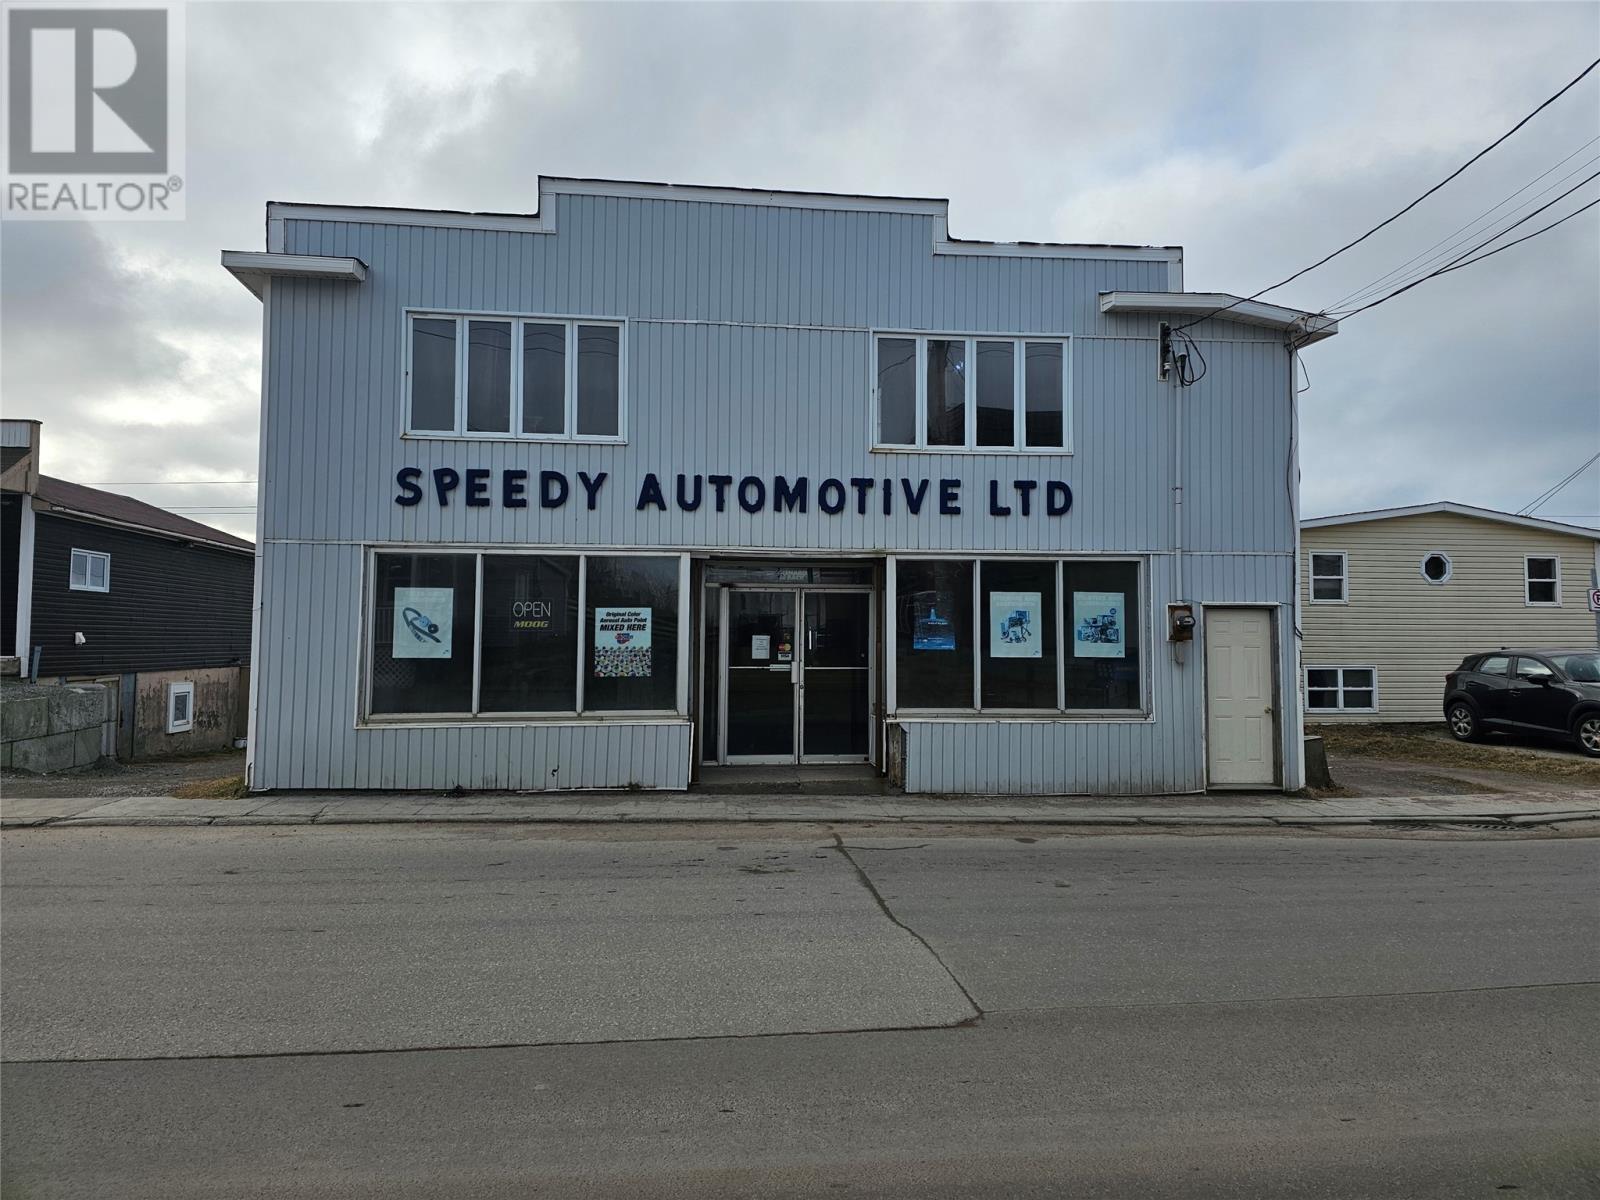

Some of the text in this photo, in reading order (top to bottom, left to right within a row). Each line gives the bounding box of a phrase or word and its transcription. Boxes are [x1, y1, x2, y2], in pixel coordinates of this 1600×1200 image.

[395, 467, 1073, 517] SPEEDY AUTOMOTIVE LTD
[513, 601, 551, 617] OPEN
[513, 620, 549, 628] MOOG
